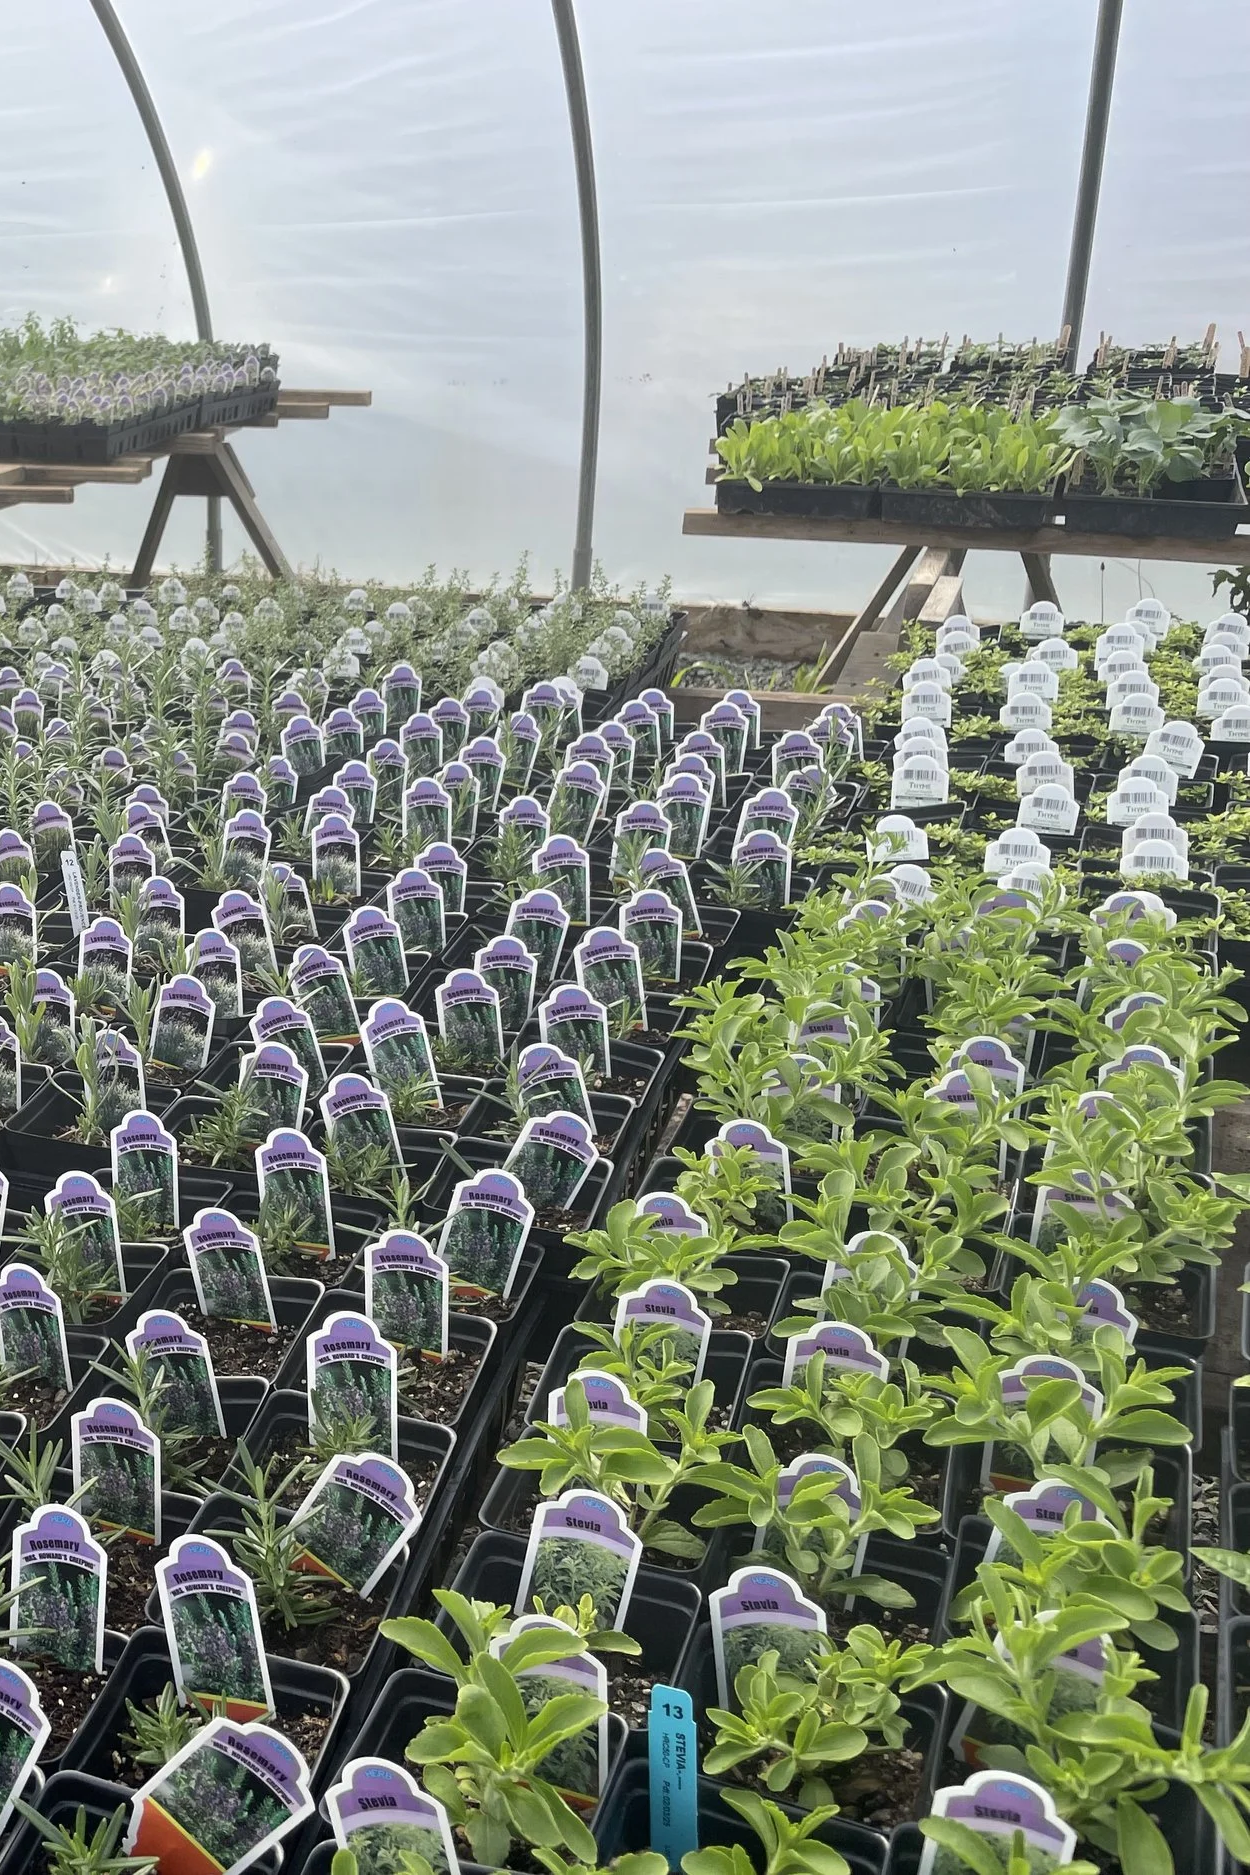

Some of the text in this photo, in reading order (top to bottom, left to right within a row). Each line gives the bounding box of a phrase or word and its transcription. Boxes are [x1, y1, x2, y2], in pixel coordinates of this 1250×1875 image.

[222, 906, 247, 918] Lavender
[522, 907, 554, 916] Rosemary
[631, 907, 665, 917] Rosemary
[486, 954, 520, 963] Rosemary
[169, 993, 197, 1001] Lavender
[447, 989, 480, 999] Rosemary
[551, 1004, 587, 1016] Rosemary
[372, 1017, 405, 1036] Rosemary
[808, 1024, 833, 1033] Stevia
[332, 1093, 368, 1109] Rosemary
[122, 1134, 157, 1143] Rosemary
[539, 1128, 580, 1146] Rosemary
[267, 1151, 305, 1162] Rosemary
[469, 1191, 513, 1205] Rosemary
[196, 1231, 236, 1243] Rosemary
[379, 1254, 424, 1264] Rosemary
[2, 1290, 40, 1300] Rosemary
[659, 1287, 682, 1298] HERB
[645, 1303, 676, 1315] Stevia
[323, 1341, 370, 1353] Rosemary
[87, 1424, 134, 1437] Rosemary
[345, 1469, 397, 1501] Rosemary
[582, 1499, 608, 1513] HERB
[1035, 1509, 1064, 1520] Stev
[51, 1515, 73, 1527] HERB
[565, 1516, 601, 1532] Stevia
[29, 1540, 79, 1551] Rosemary
[173, 1569, 223, 1584] Rosemary
[751, 1576, 778, 1587] HERB
[740, 1599, 779, 1611] Stevia
[662, 1703, 684, 1720] 13
[228, 1735, 288, 1782] Rosemary
[365, 1769, 393, 1780] HERB
[357, 1795, 397, 1810] Stevia
[973, 1804, 1021, 1823] Stevia
